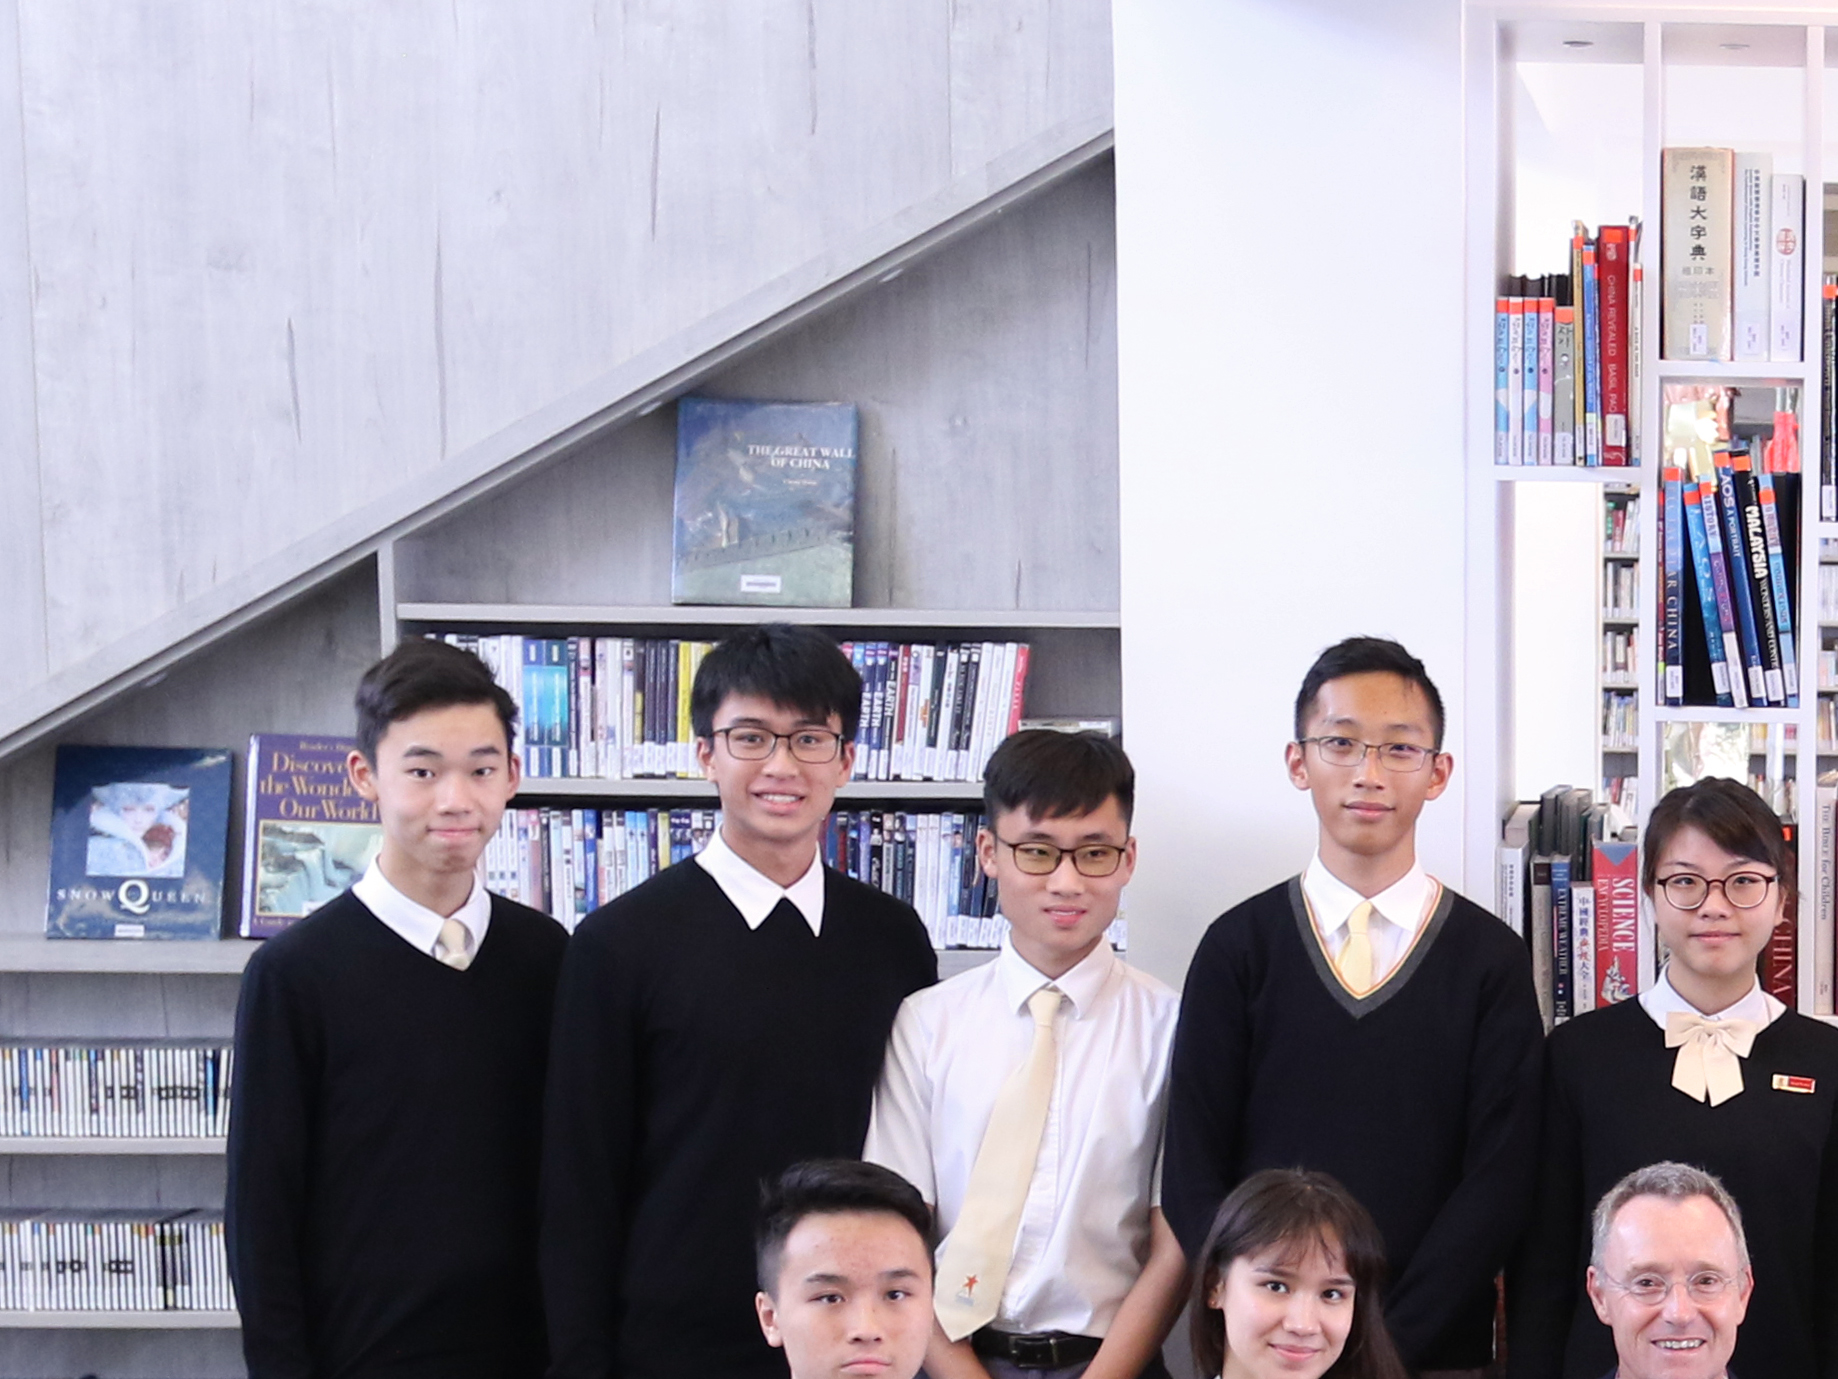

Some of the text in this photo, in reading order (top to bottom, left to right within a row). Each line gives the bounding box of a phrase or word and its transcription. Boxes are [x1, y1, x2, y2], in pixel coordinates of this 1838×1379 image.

[1688, 164, 1709, 262] 漢語大字典
[1607, 275, 1618, 357] CHINA REVEALED
[1607, 363, 1617, 390] BASIL
[748, 444, 855, 459] THE GREAT WALL
[770, 458, 831, 470] OF CHINA
[1728, 516, 1742, 558] PORTRAIT
[1744, 505, 1769, 579] MALAYSIA
[1666, 595, 1678, 650] CHINA
[859, 691, 873, 728] EARTH
[871, 691, 884, 728] EARTH
[884, 681, 897, 717] EARTH
[260, 775, 353, 797] the Wond
[279, 799, 380, 821] Our World
[1820, 859, 1830, 875] for
[56, 879, 206, 914] SNOW QUEEN
[1597, 877, 1610, 952] ENCYCLOPEDIA
[1611, 877, 1636, 953] SCIENCE
[1820, 875, 1830, 921] Children
[1557, 887, 1568, 976] EXTREME WEATHER
